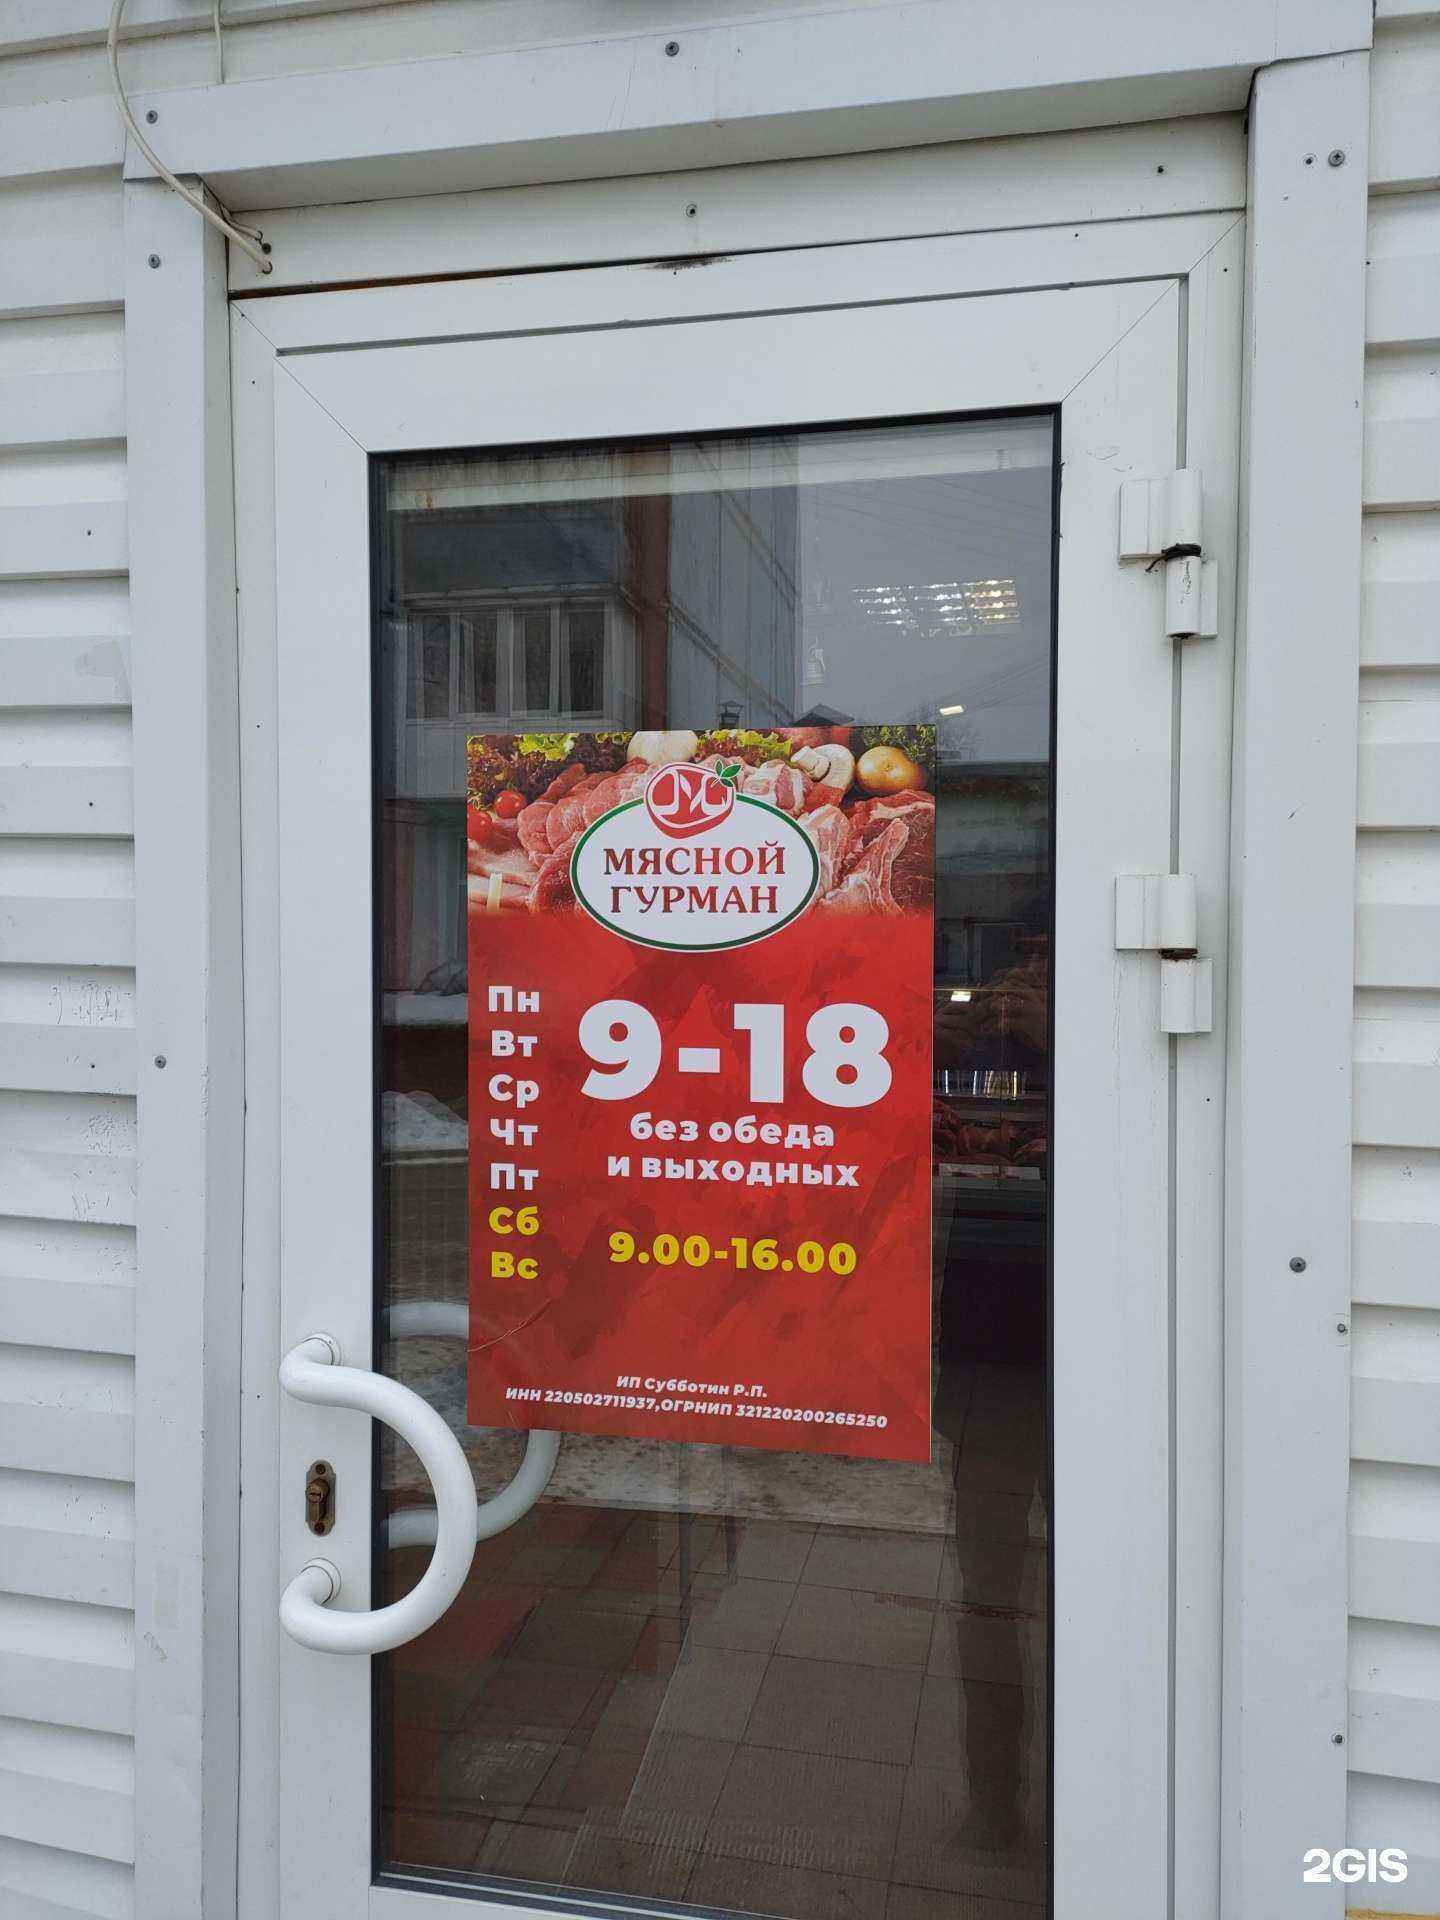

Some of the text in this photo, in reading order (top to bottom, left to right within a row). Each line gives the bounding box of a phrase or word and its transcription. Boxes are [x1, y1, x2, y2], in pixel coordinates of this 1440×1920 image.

[603, 840, 786, 875] МЯСНОЙ
[610, 885, 778, 914] ГУРМАН
[488, 985, 540, 1013] Пн
[491, 1030, 538, 1057] Вт
[578, 999, 893, 1108] 9-18
[488, 1073, 540, 1108] Ср
[490, 1118, 539, 1146] Чт
[629, 1111, 834, 1149] без обеда
[490, 1163, 539, 1191] Пт
[607, 1156, 860, 1187] и выходных
[488, 1205, 540, 1236] Сб
[491, 1251, 539, 1280] Вс
[608, 1231, 857, 1275] 9.00-16.00
[616, 1375, 768, 1398] ИП Субботин Р.П.
[505, 1387, 541, 1401] ИНН
[734, 1403, 888, 1429] 321220200265250
